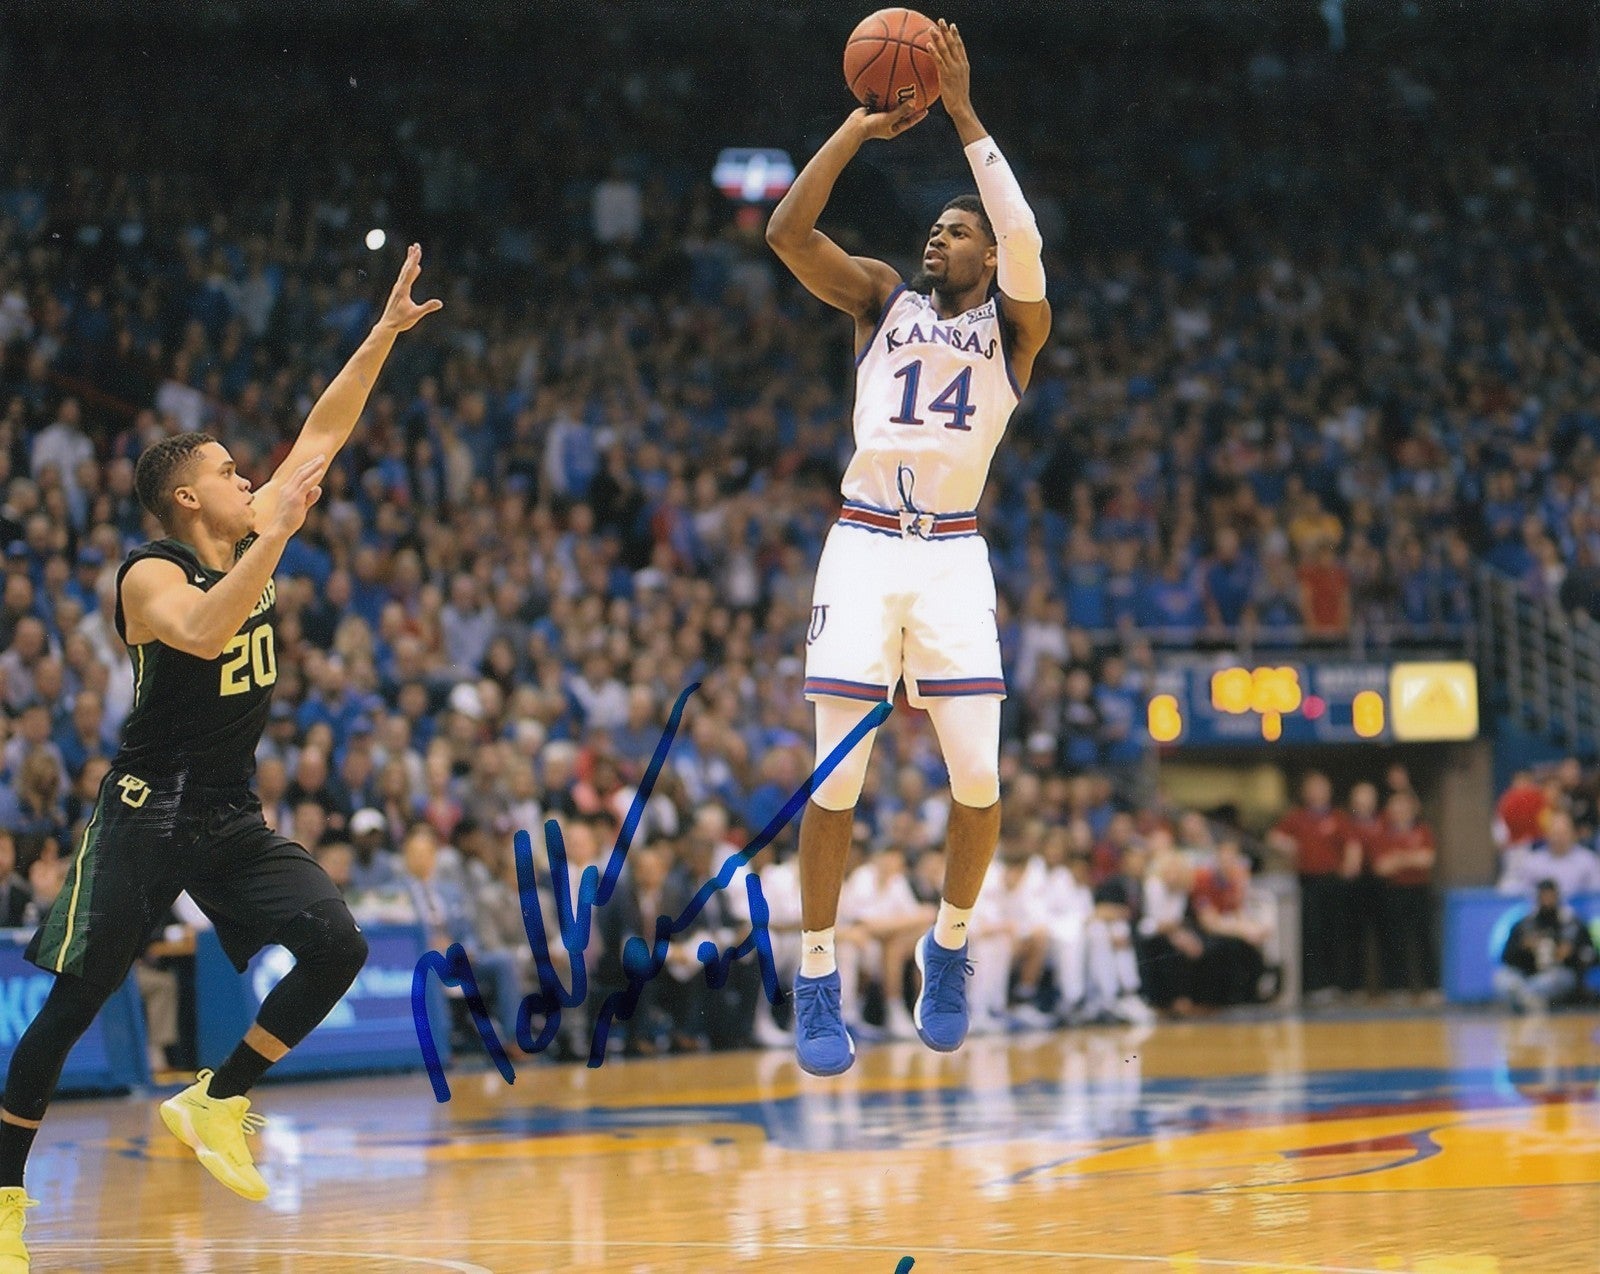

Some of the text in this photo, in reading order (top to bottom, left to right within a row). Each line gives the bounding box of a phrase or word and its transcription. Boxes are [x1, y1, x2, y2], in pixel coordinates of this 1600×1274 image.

[886, 322, 997, 360] KANSAS
[889, 359, 977, 431] 14
[219, 622, 278, 697] 20
